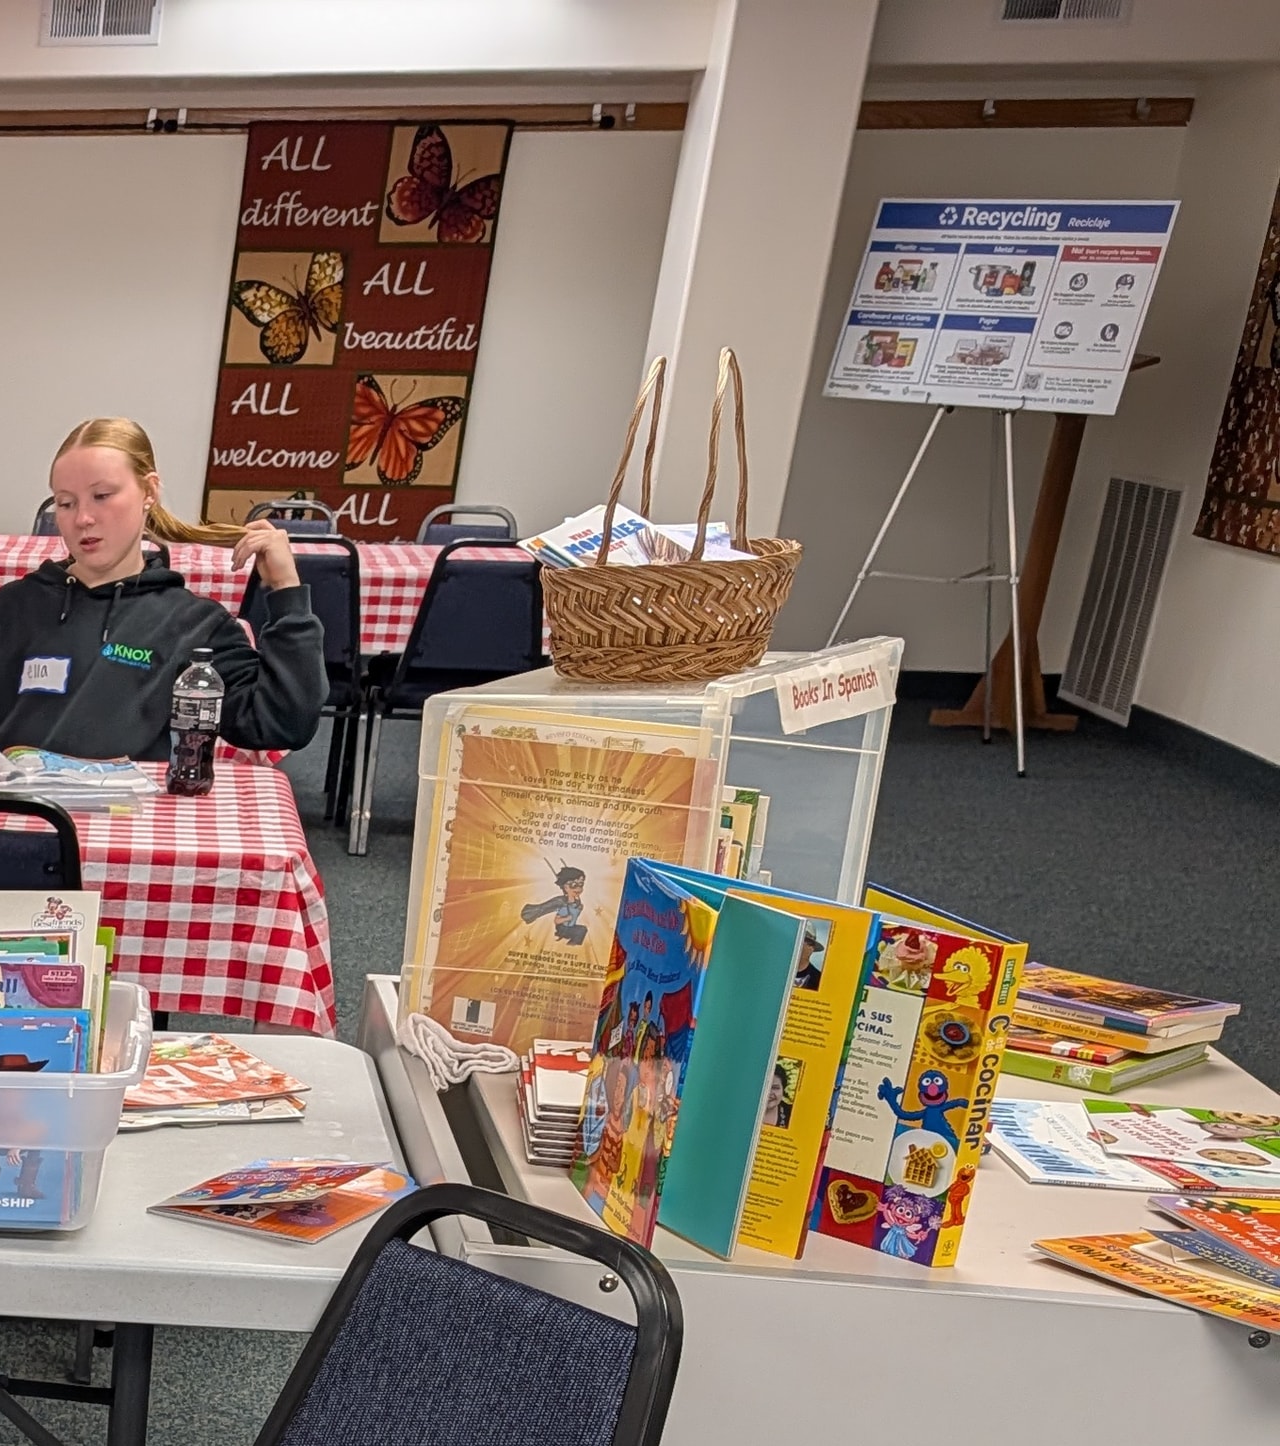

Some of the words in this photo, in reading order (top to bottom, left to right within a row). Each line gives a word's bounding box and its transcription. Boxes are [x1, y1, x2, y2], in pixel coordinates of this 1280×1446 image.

[261, 135, 332, 172] ALL
[242, 191, 379, 228] different
[961, 207, 1061, 231] Recycling
[1068, 217, 1111, 229] Reciclaje
[993, 244, 1014, 254] Metal
[363, 261, 434, 296] ALL
[344, 317, 477, 352] beautiful
[231, 382, 300, 416] ALL
[213, 442, 340, 469] welcome
[333, 493, 398, 526] ALL
[114, 644, 153, 663] KNOX
[27, 663, 49, 678] ella
[792, 681, 819, 710] Books
[822, 678, 834, 701] In
[838, 665, 878, 702] Spanish
[545, 768, 571, 779] Follow
[550, 777, 563, 786] the
[588, 781, 604, 791] with
[607, 783, 646, 795] kindness
[566, 796, 600, 809] animals
[603, 800, 621, 810] and
[522, 810, 544, 822] Sigue
[555, 813, 593, 825] Ricardito
[596, 817, 633, 829] mientras
[499, 824, 533, 837] aprende
[559, 832, 591, 843] amable
[593, 835, 627, 848] consigo
[571, 825, 586, 833] con
[590, 824, 639, 840] amabilidad
[571, 840, 609, 854] animales
[870, 1011, 893, 1024] SUS
[1068, 1243, 1108, 1263] KIND
[1112, 1260, 1175, 1286] SUPER
